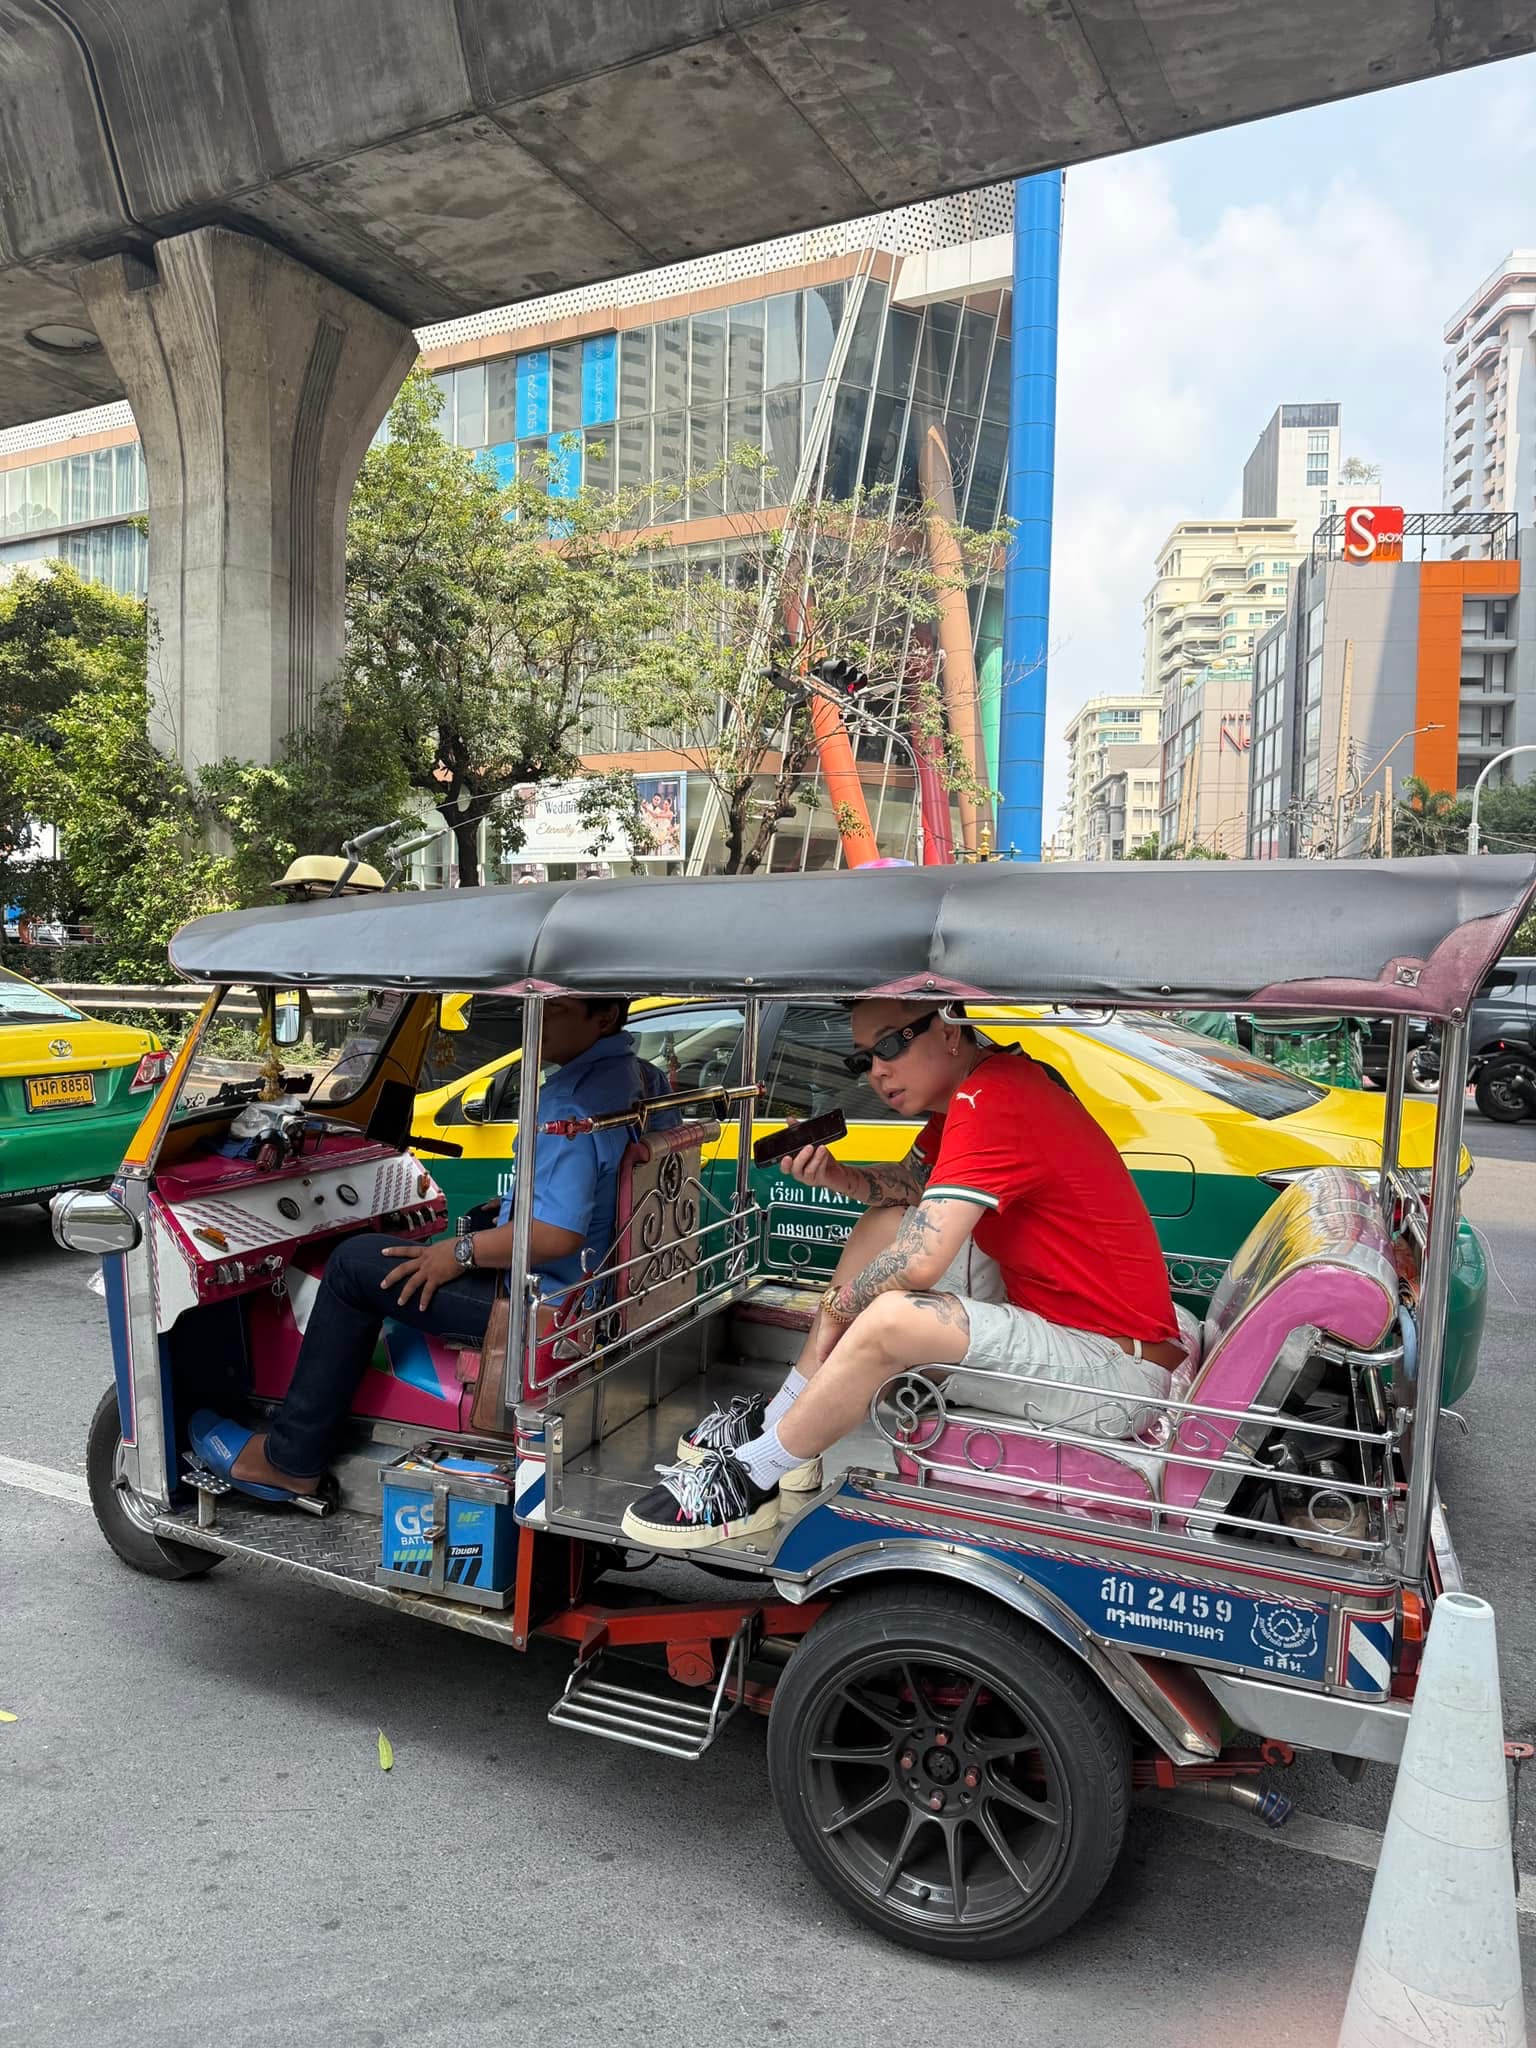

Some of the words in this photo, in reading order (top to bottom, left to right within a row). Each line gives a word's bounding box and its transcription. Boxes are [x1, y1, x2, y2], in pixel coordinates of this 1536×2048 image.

[1349, 508, 1377, 558] S
[1377, 532, 1404, 544] BOX
[61, 1078, 90, 1094] 8858
[770, 1181, 804, 1202] เรียก
[1147, 1586, 1233, 1623] 2459
[1106, 1606, 1225, 1642] กรุงเทพมหานคร
